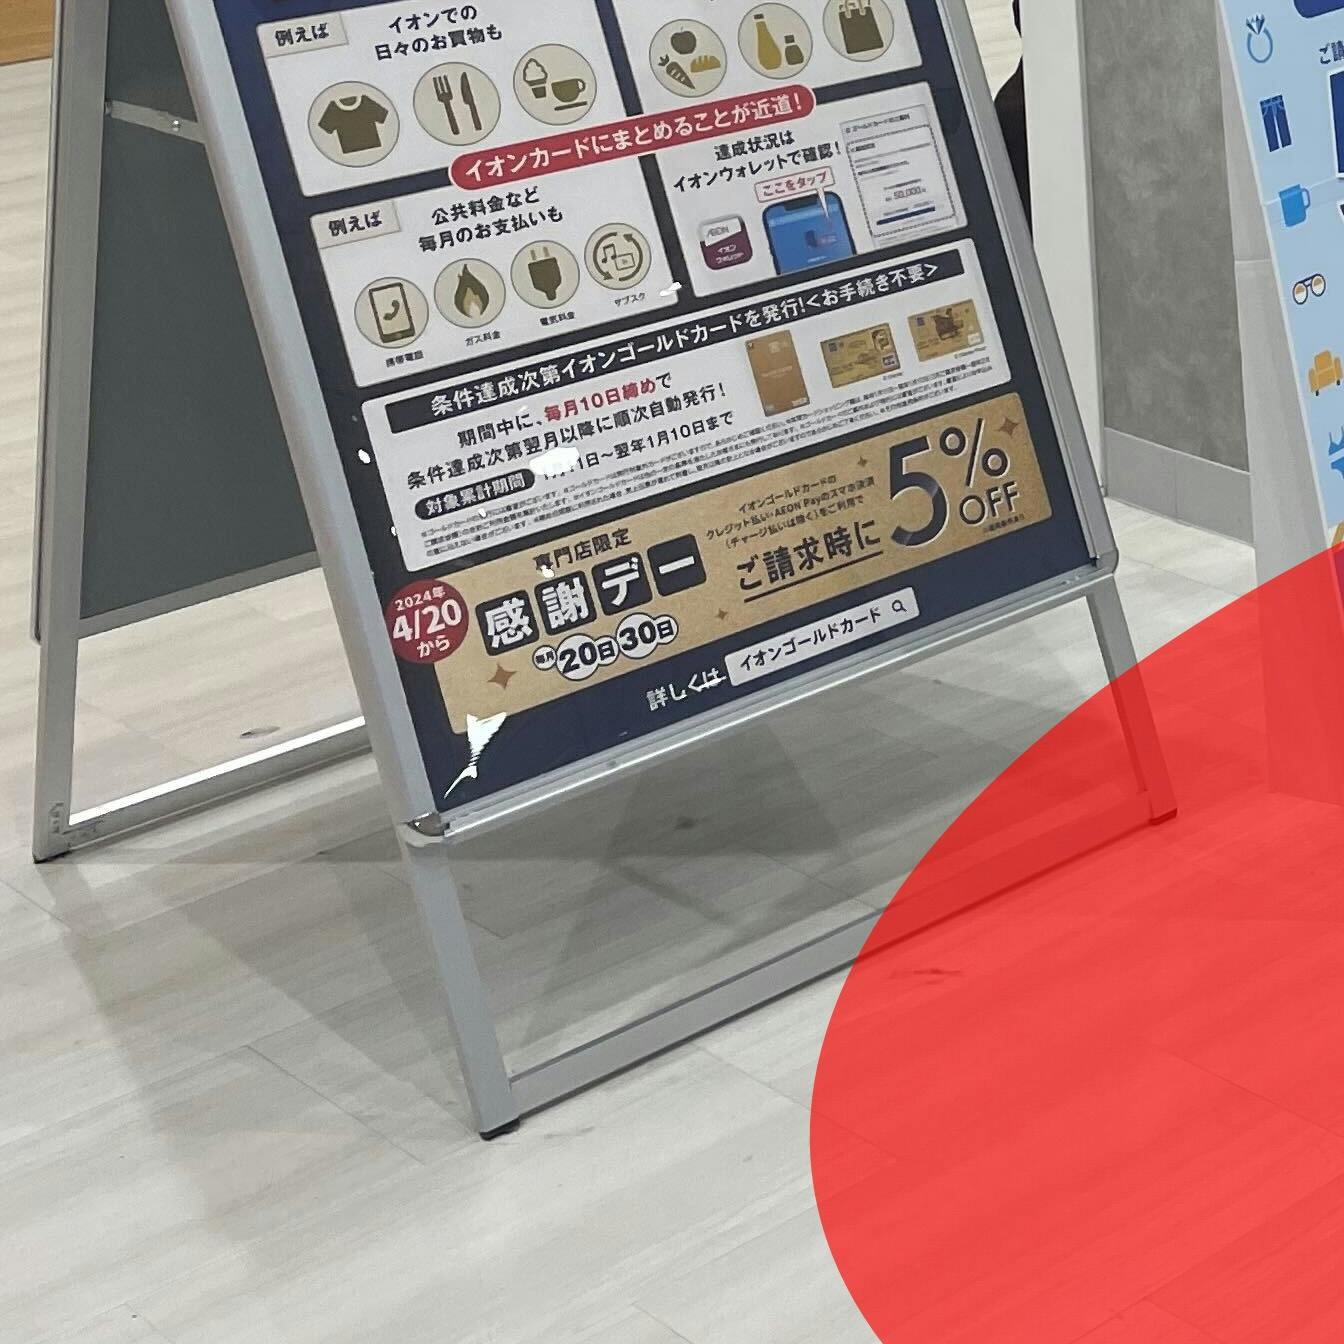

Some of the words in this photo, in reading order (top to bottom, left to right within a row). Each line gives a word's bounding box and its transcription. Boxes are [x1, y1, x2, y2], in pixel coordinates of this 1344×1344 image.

[275, 22, 330, 47] 例えば
[388, 5, 478, 34] イオンでの
[375, 24, 502, 61] 日々のお買物も
[465, 92, 803, 182] イオンカードにまとめることが近道!
[713, 130, 796, 161] 達成状況は
[673, 141, 841, 193] イオンウォレットで確認!
[763, 170, 828, 197] ここをタップ
[328, 210, 383, 237] 例えば
[431, 185, 541, 227] 公共料金など
[418, 206, 563, 253] 毎月のお支払いも
[457, 372, 673, 448] 期間中に、毎月10日締めで
[407, 383, 728, 490] 条件達成次第翌月以降に順次自動発行!
[738, 474, 837, 514] イオンゴールドカードの
[890, 417, 1009, 547] 5%
[959, 481, 1019, 525] OFF
[726, 495, 864, 549] (チャージ払いは除く)をご利用で
[736, 519, 881, 591] ご請求時に
[395, 586, 446, 611] 2024年
[486, 556, 695, 649] 感謝デー
[393, 600, 462, 642] 4/20
[417, 638, 451, 658] から
[646, 668, 727, 712] 詳しくは
[740, 607, 882, 672] イオンゴールドカード
